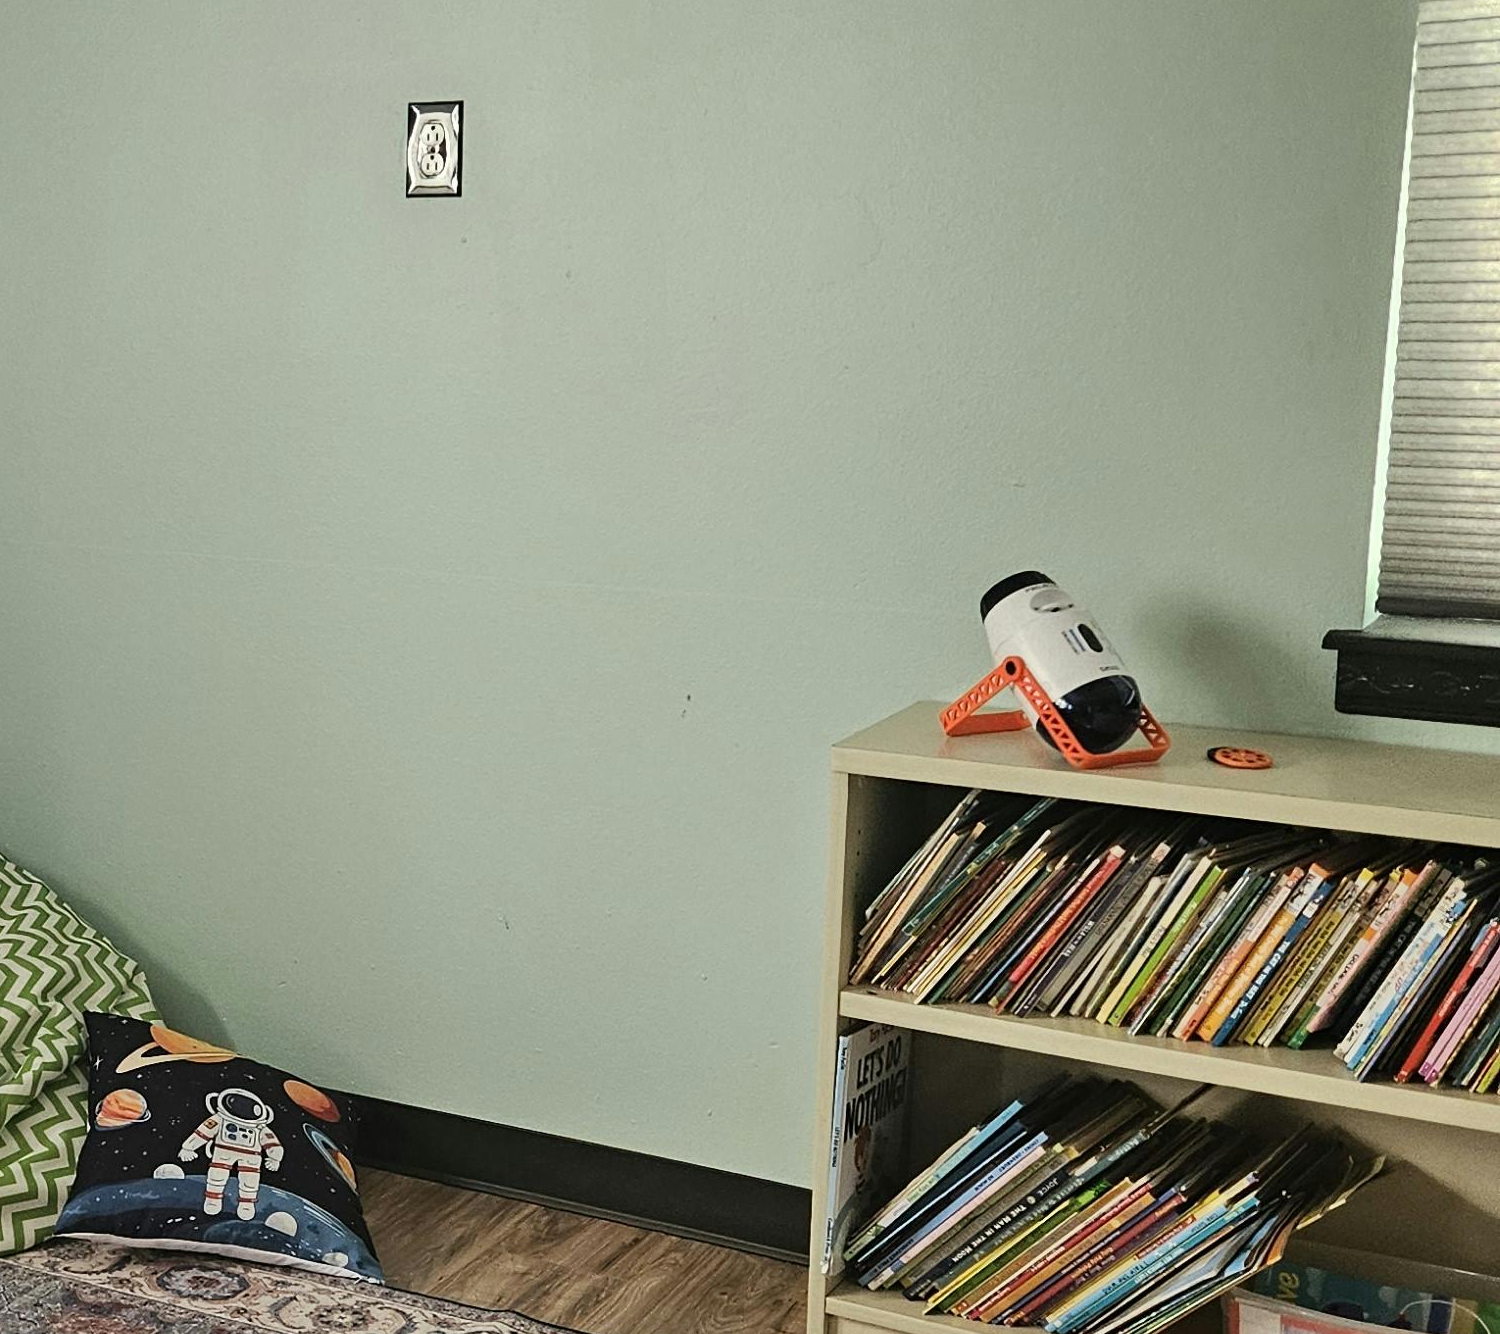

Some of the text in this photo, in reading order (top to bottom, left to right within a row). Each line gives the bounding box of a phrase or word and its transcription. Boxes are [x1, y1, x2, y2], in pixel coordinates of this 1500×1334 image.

[856, 1044, 886, 1091] LET'S
[884, 1035, 902, 1073] DO
[950, 1176, 1060, 1263] JOYCE THE MAN IN THE MOON
